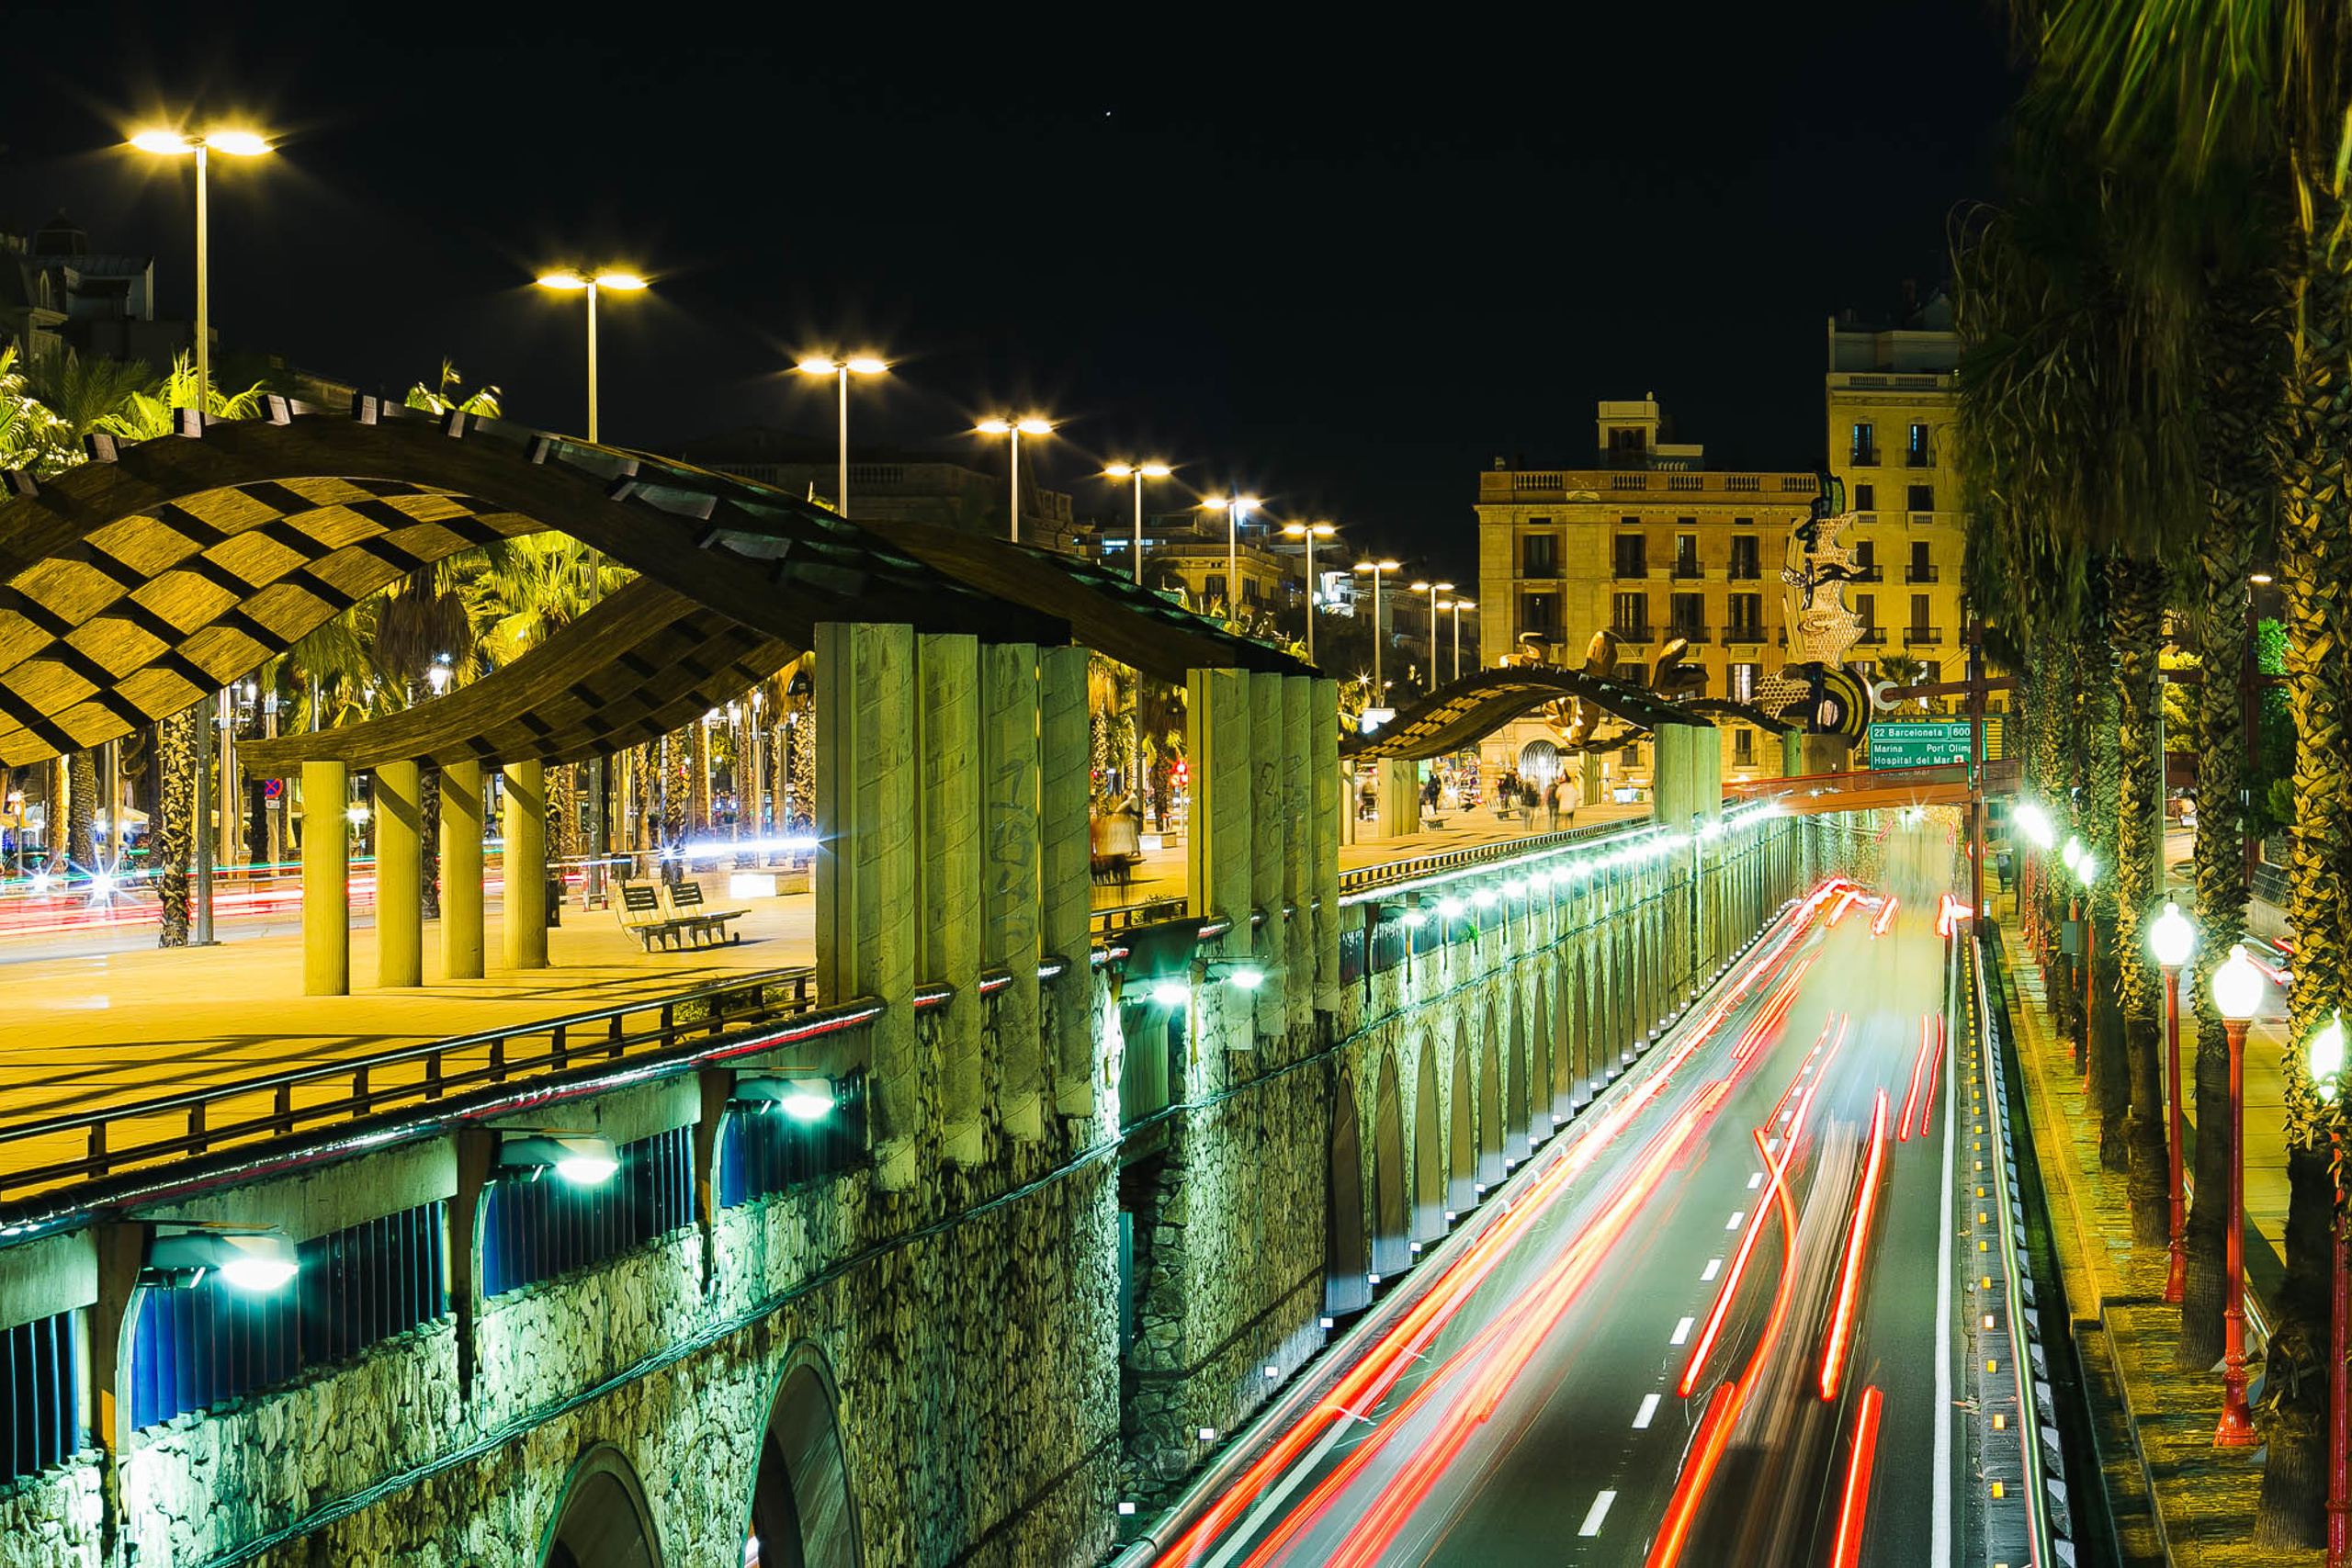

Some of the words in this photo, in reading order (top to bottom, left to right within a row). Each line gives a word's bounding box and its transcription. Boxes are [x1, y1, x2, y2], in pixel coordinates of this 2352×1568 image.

[1874, 728, 1884, 737] 22
[1888, 728, 1943, 737] Barceloneta
[1874, 744, 1903, 752] Marina
[1927, 744, 1944, 752] Port
[1874, 756, 1912, 765] Hospital
[1916, 756, 1929, 764] del
[1933, 755, 1951, 764] Mar
